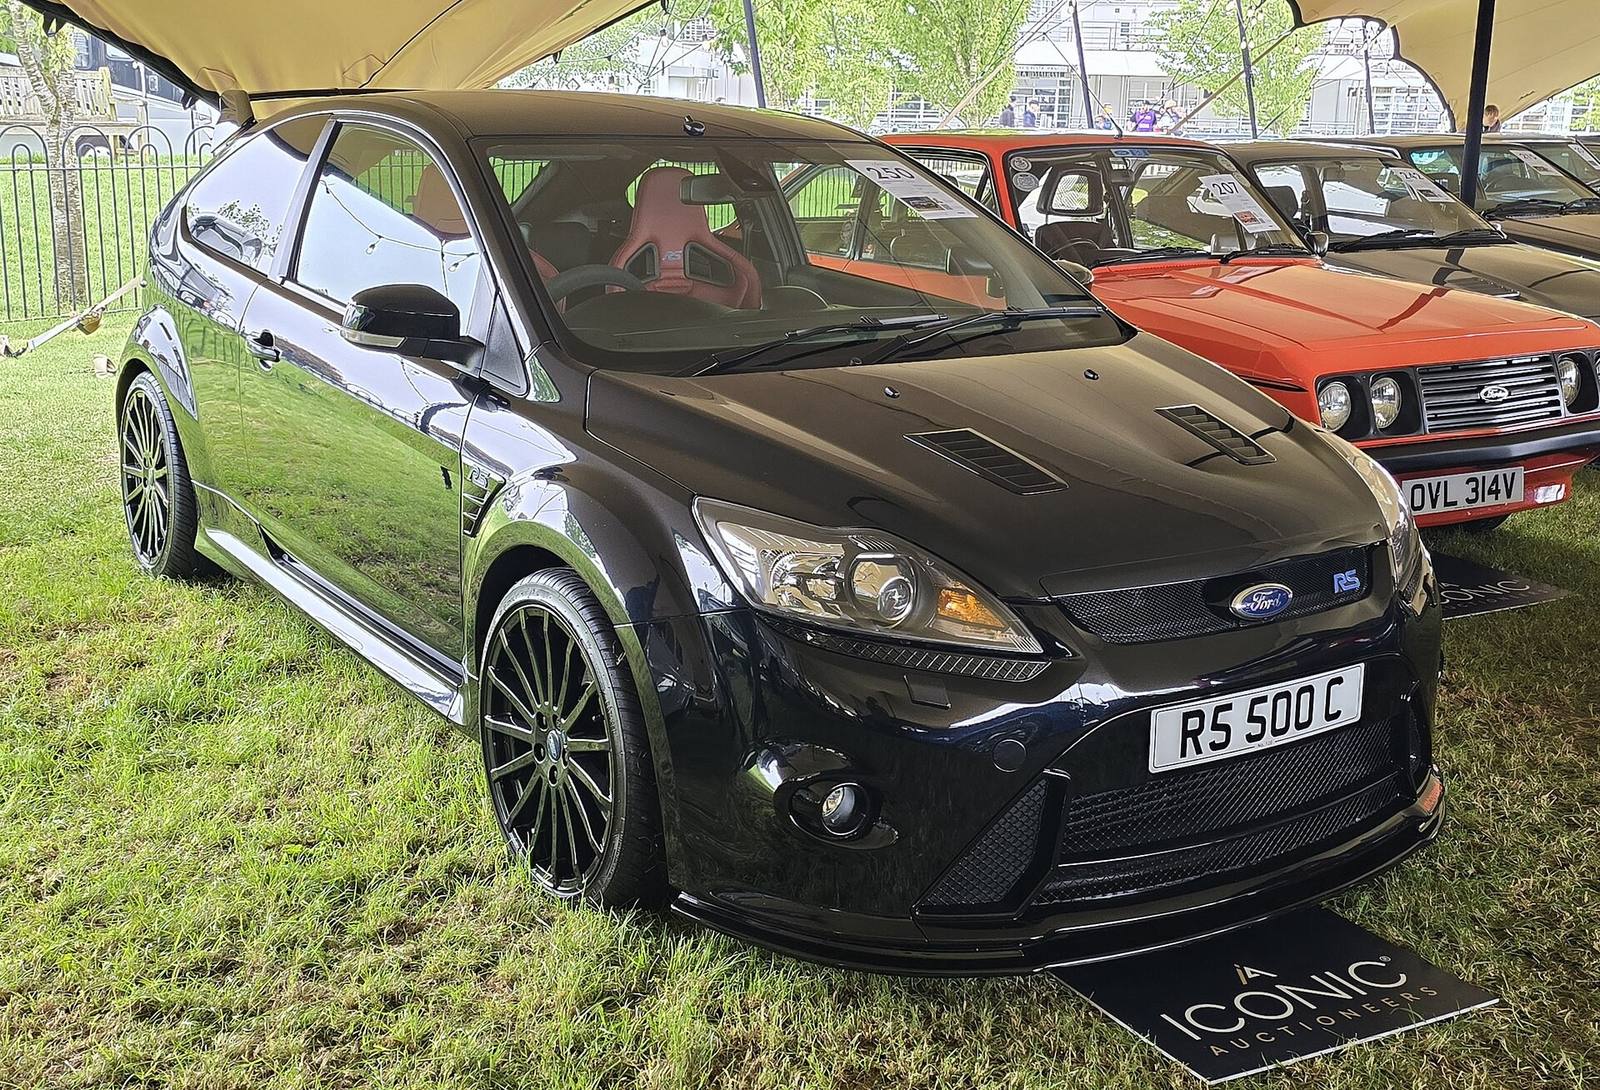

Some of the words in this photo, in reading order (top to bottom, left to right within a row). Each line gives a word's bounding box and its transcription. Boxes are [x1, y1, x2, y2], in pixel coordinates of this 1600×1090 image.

[866, 167, 915, 180] 250
[1212, 181, 1240, 195] 207
[1410, 480, 1458, 512] OVL
[1465, 471, 1516, 505] 314V
[1333, 569, 1361, 593] RS
[1441, 580, 1530, 604] ONIC
[1244, 589, 1282, 611] Ford
[1245, 684, 1315, 743] 500
[1324, 676, 1344, 722] C
[1160, 960, 1407, 1041] ICONIC
[1209, 985, 1437, 1057] AUCTIONEERS
